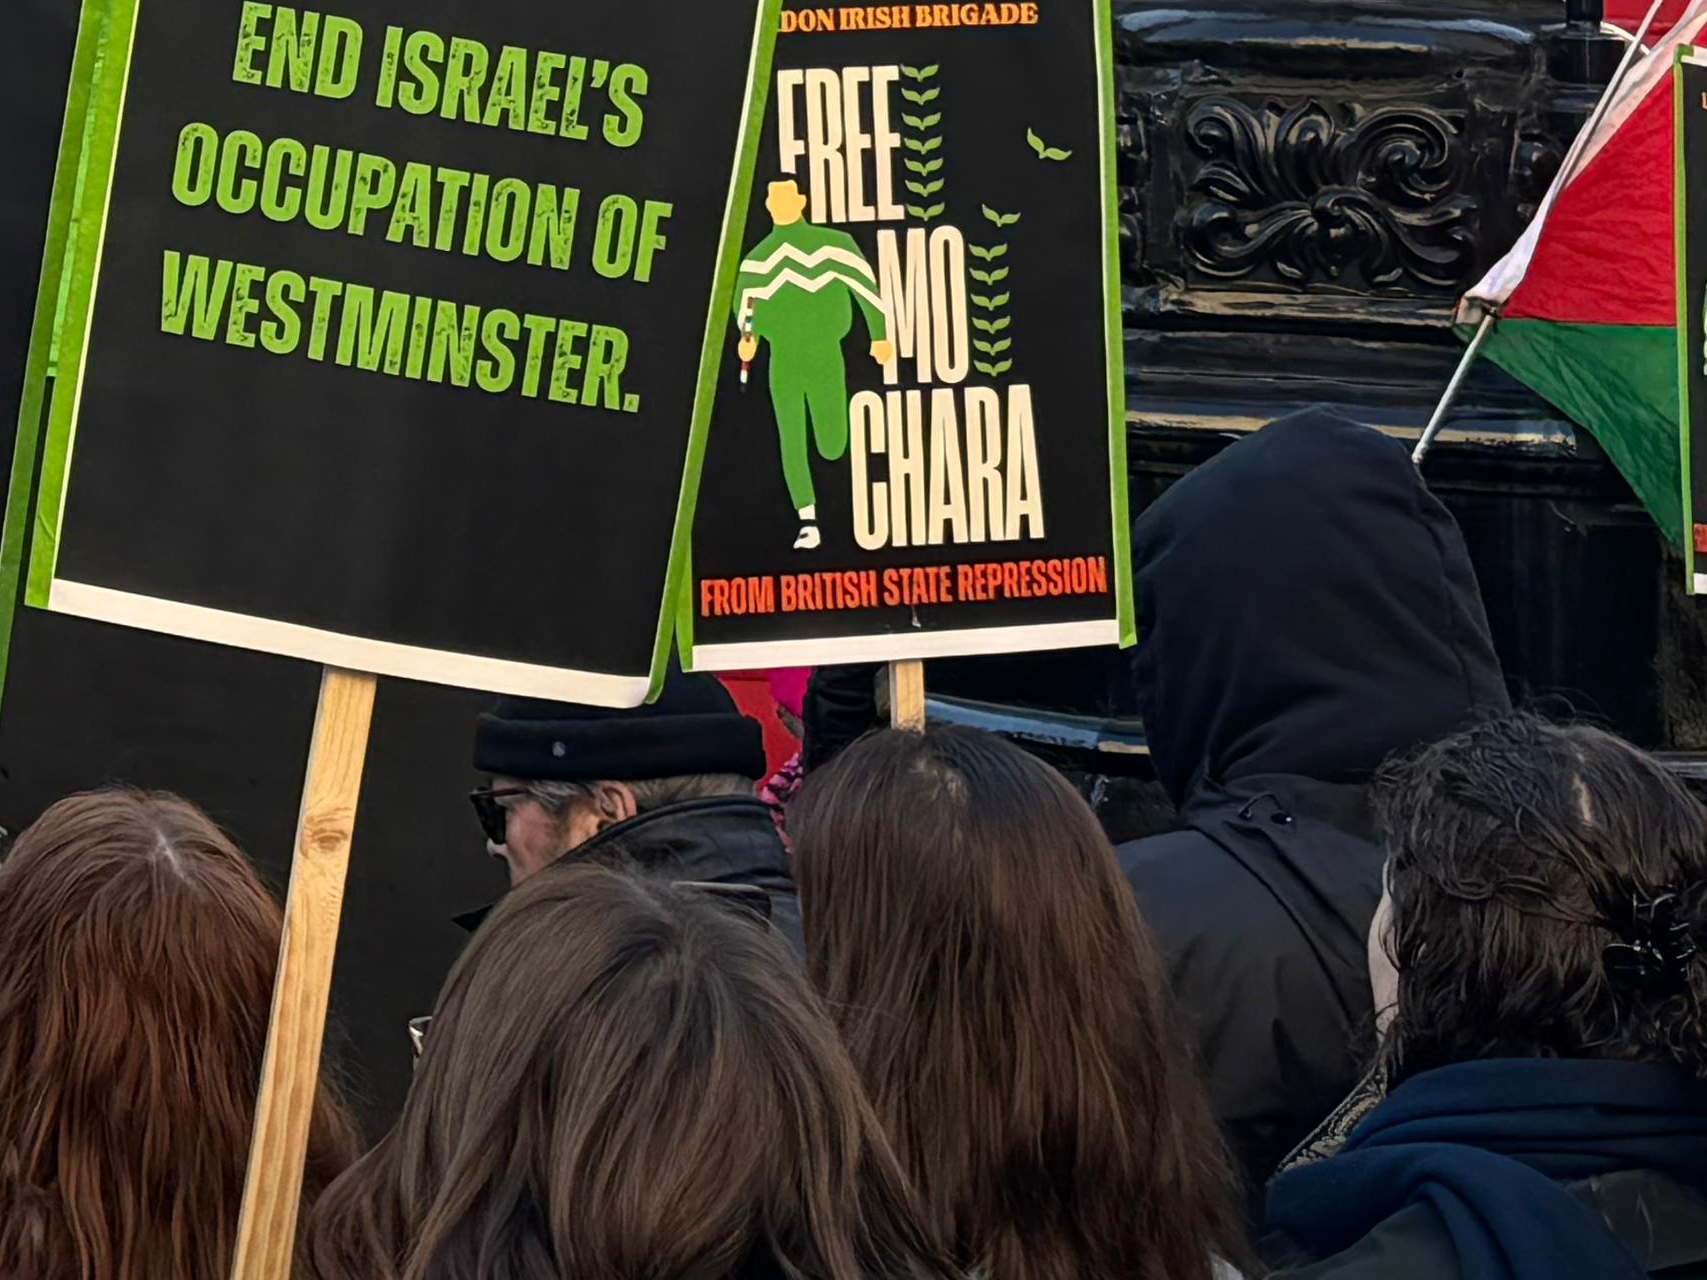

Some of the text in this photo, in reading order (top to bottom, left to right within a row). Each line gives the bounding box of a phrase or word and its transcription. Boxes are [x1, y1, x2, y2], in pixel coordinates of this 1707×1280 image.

[232, 0, 649, 148] END ISRAEL'S
[839, 4, 911, 30] IRISH
[915, 2, 1039, 27] BRIGADE
[172, 121, 673, 284] OCCUPATION OF
[777, 65, 904, 224] FREE
[160, 250, 640, 412] WESTMINSTER.
[876, 225, 968, 385] MO
[849, 384, 1044, 550] CHARA
[700, 556, 1108, 617] FROM BRITISH STATE REPRESSION
